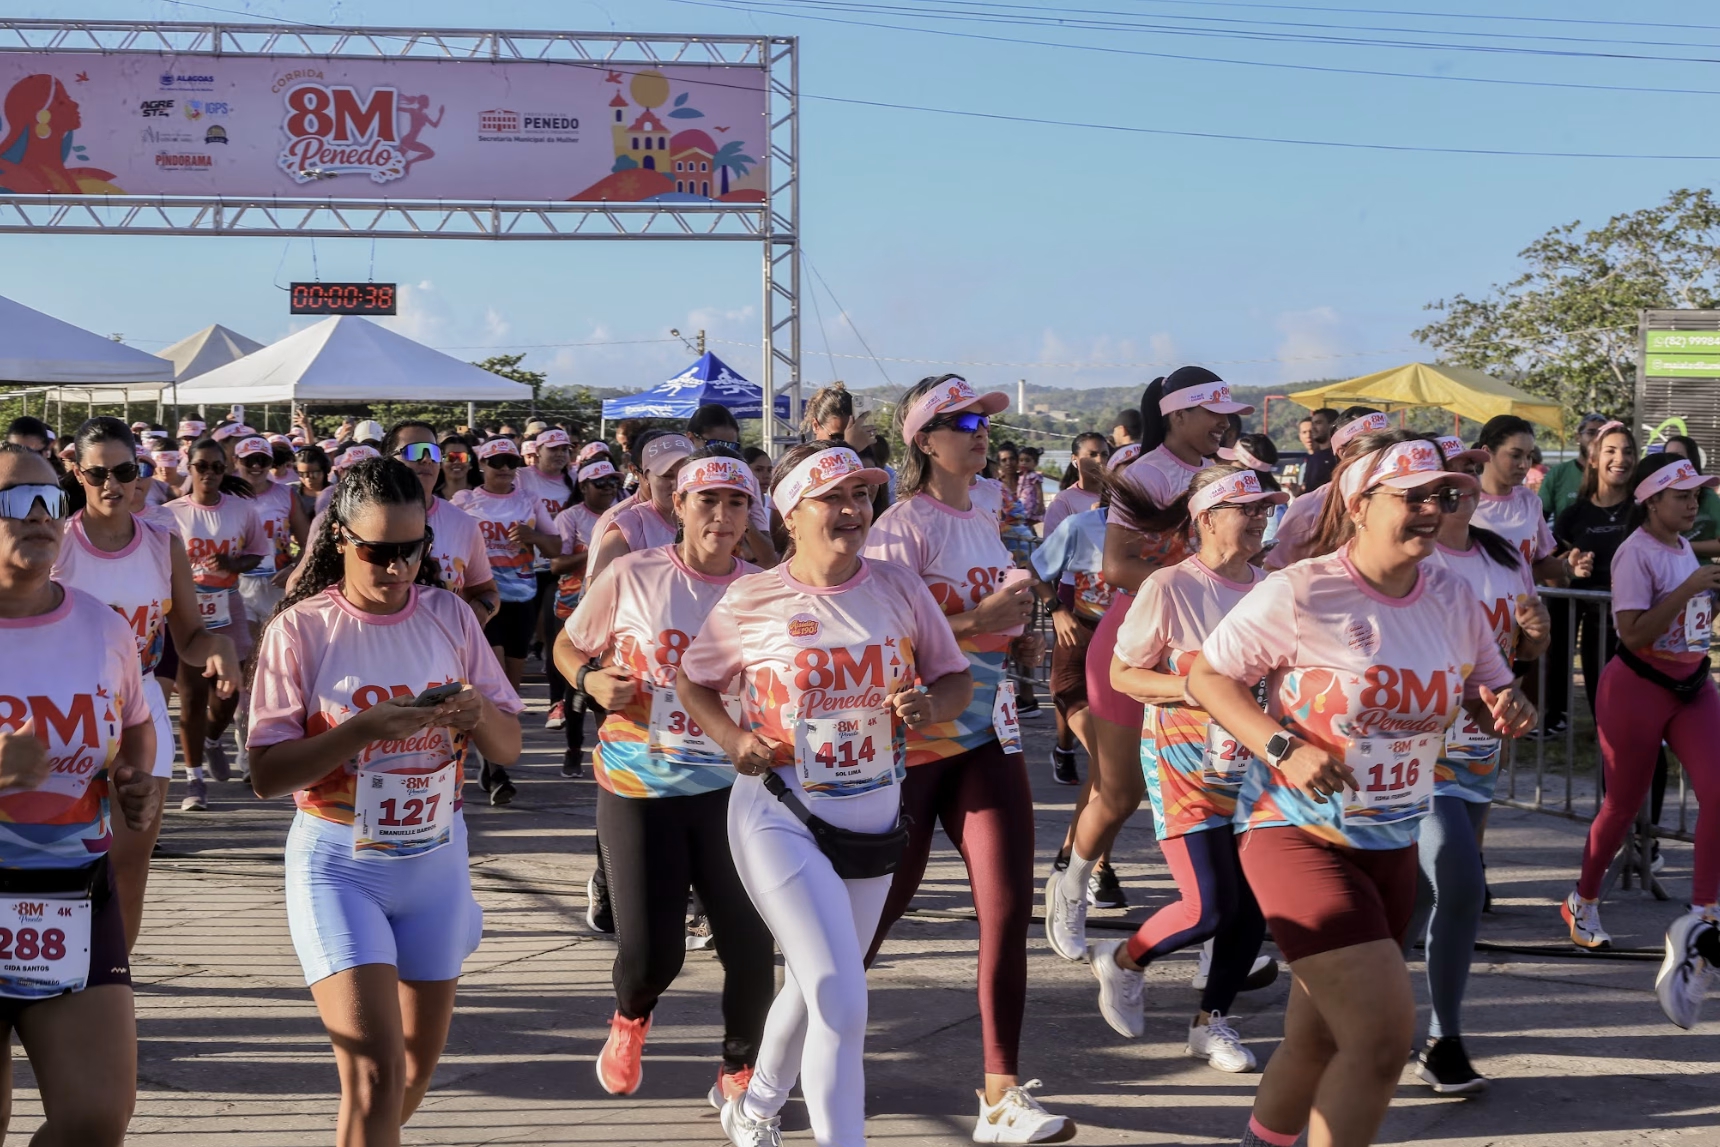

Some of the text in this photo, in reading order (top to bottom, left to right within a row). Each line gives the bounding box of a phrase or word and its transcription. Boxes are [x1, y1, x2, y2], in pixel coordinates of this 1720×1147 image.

[271, 69, 324, 94] CORRIDA
[140, 100, 175, 109] AGRE
[205, 102, 228, 114] IGPS
[287, 87, 396, 142] 8M
[524, 117, 579, 129] PENEDO
[155, 155, 212, 166] PINDORAMA
[289, 136, 393, 171] Penedo
[293, 286, 393, 308] 00:00:38
[1665, 336, 1686, 348] (82)
[648, 438, 694, 458] Sta
[706, 462, 727, 473] 8M
[820, 454, 844, 469] 8M
[187, 537, 230, 558] 8M
[794, 645, 886, 691] 8M
[1359, 664, 1448, 716] 8M
[797, 685, 882, 718] Penedo
[837, 717, 877, 732] 8M 4K
[1355, 707, 1439, 735] Penedo
[815, 735, 876, 768] 414
[1220, 740, 1254, 761] 24
[1393, 740, 1412, 753] 8M
[406, 777, 429, 789] 8M
[1366, 758, 1420, 791] 116
[378, 793, 441, 826] 127
[18, 902, 72, 917] 8M 4K
[0, 927, 66, 961] 288
